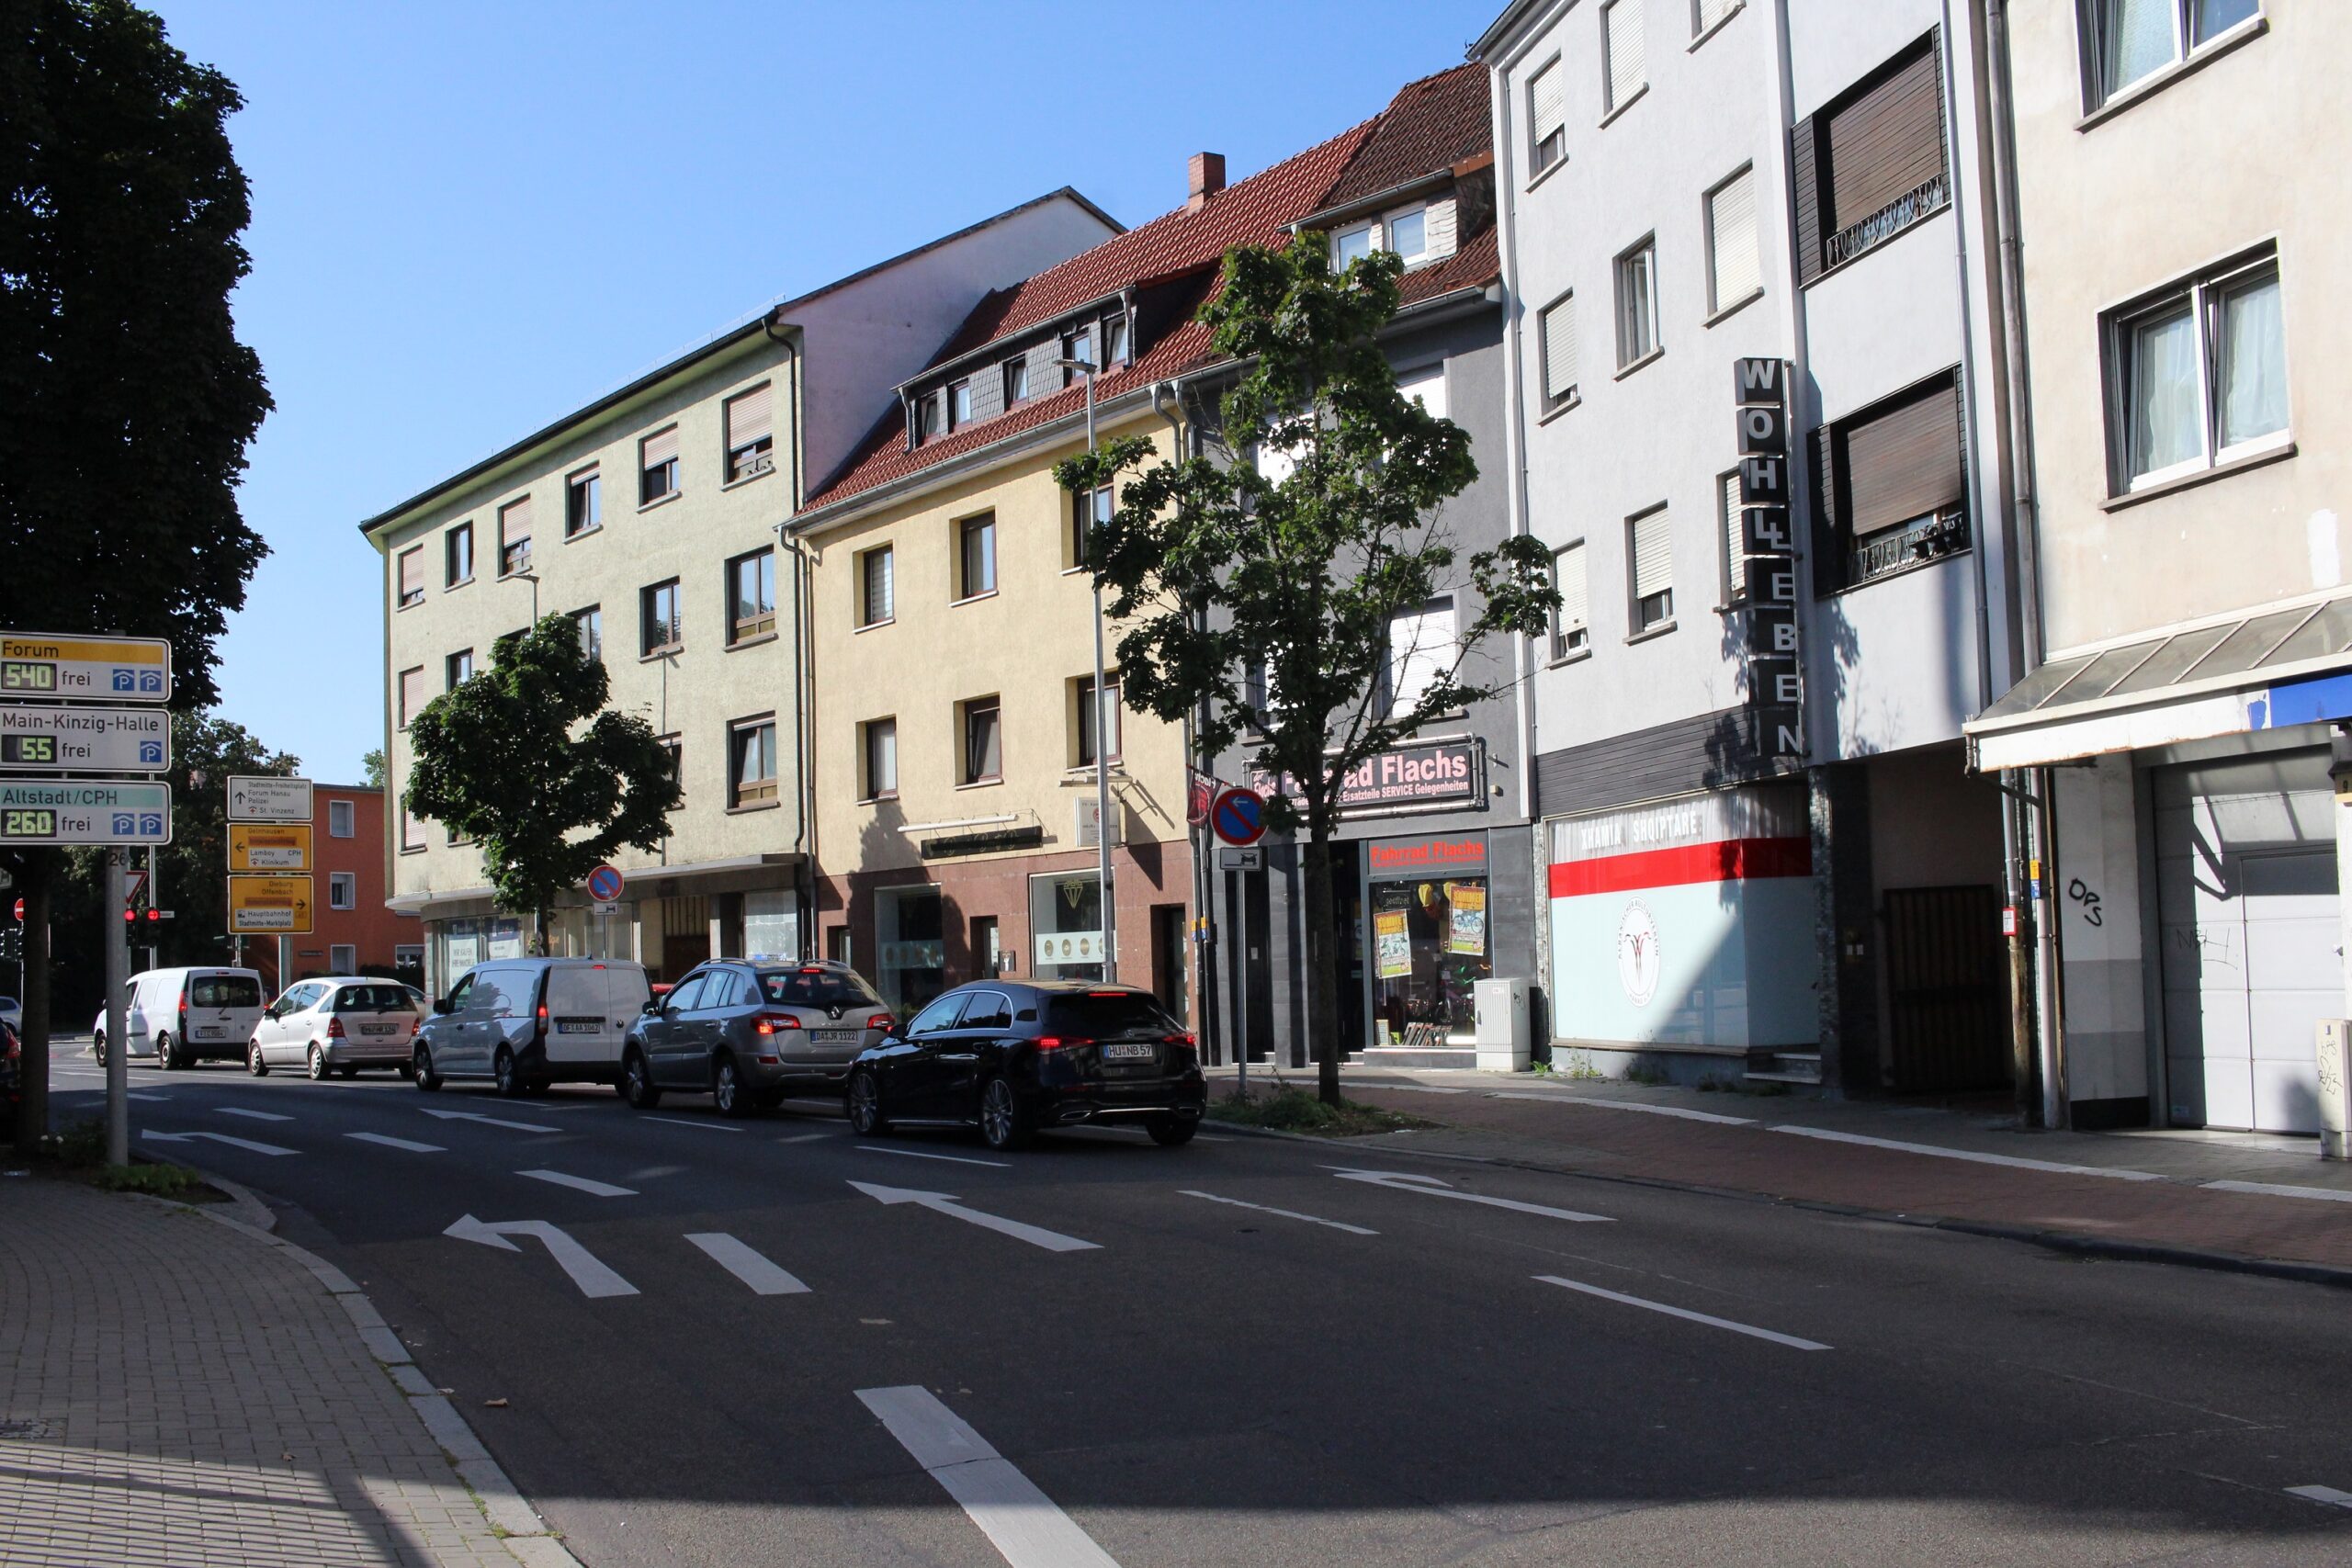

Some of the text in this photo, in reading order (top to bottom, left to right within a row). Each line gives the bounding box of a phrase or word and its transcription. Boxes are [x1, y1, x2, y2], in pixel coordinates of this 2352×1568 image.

[2, 640, 60, 658] Forum
[6, 663, 51, 688] 540
[62, 671, 91, 686] frei
[2, 713, 159, 733] Main-Kinzig-Halle
[21, 738, 51, 760] 55
[62, 742, 91, 759] frei
[1382, 749, 1467, 783] Flachs
[2, 788, 118, 807] Altstadt/CPH
[1342, 787, 1381, 802] Ersatzteile
[1382, 784, 1414, 799] SERVICE
[1415, 779, 1468, 795] Gelegenheiten
[6, 811, 51, 834] 260
[62, 817, 91, 832] frei
[1581, 809, 1698, 850] XHAMIA SHQIPTARE
[108, 853, 127, 866] 26
[1371, 843, 1429, 863] Fahrrad
[1433, 839, 1485, 857] Flachs
[247, 909, 292, 918] Hauptbahnhof
[838, 1032, 855, 1040] 1122
[1109, 1045, 1151, 1056] HU NB 57
